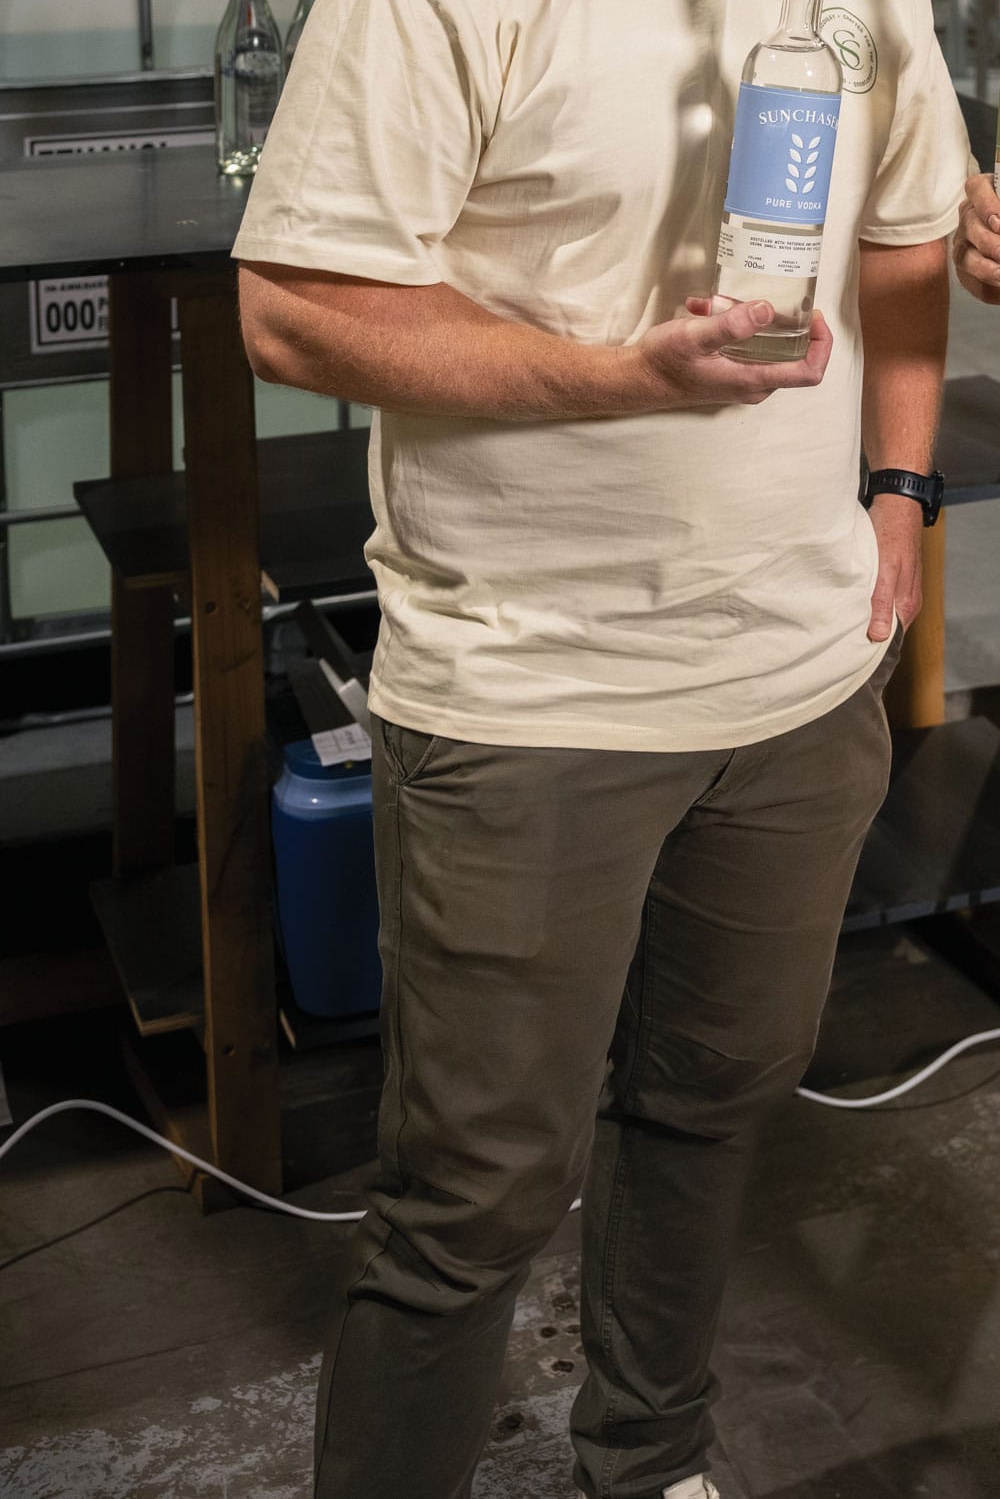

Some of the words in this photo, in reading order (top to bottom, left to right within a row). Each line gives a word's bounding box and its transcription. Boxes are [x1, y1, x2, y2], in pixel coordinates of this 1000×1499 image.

[766, 197, 792, 208] PURE
[798, 200, 822, 210] VODKA
[744, 260, 765, 270] 700ml
[46, 299, 95, 333] 000
